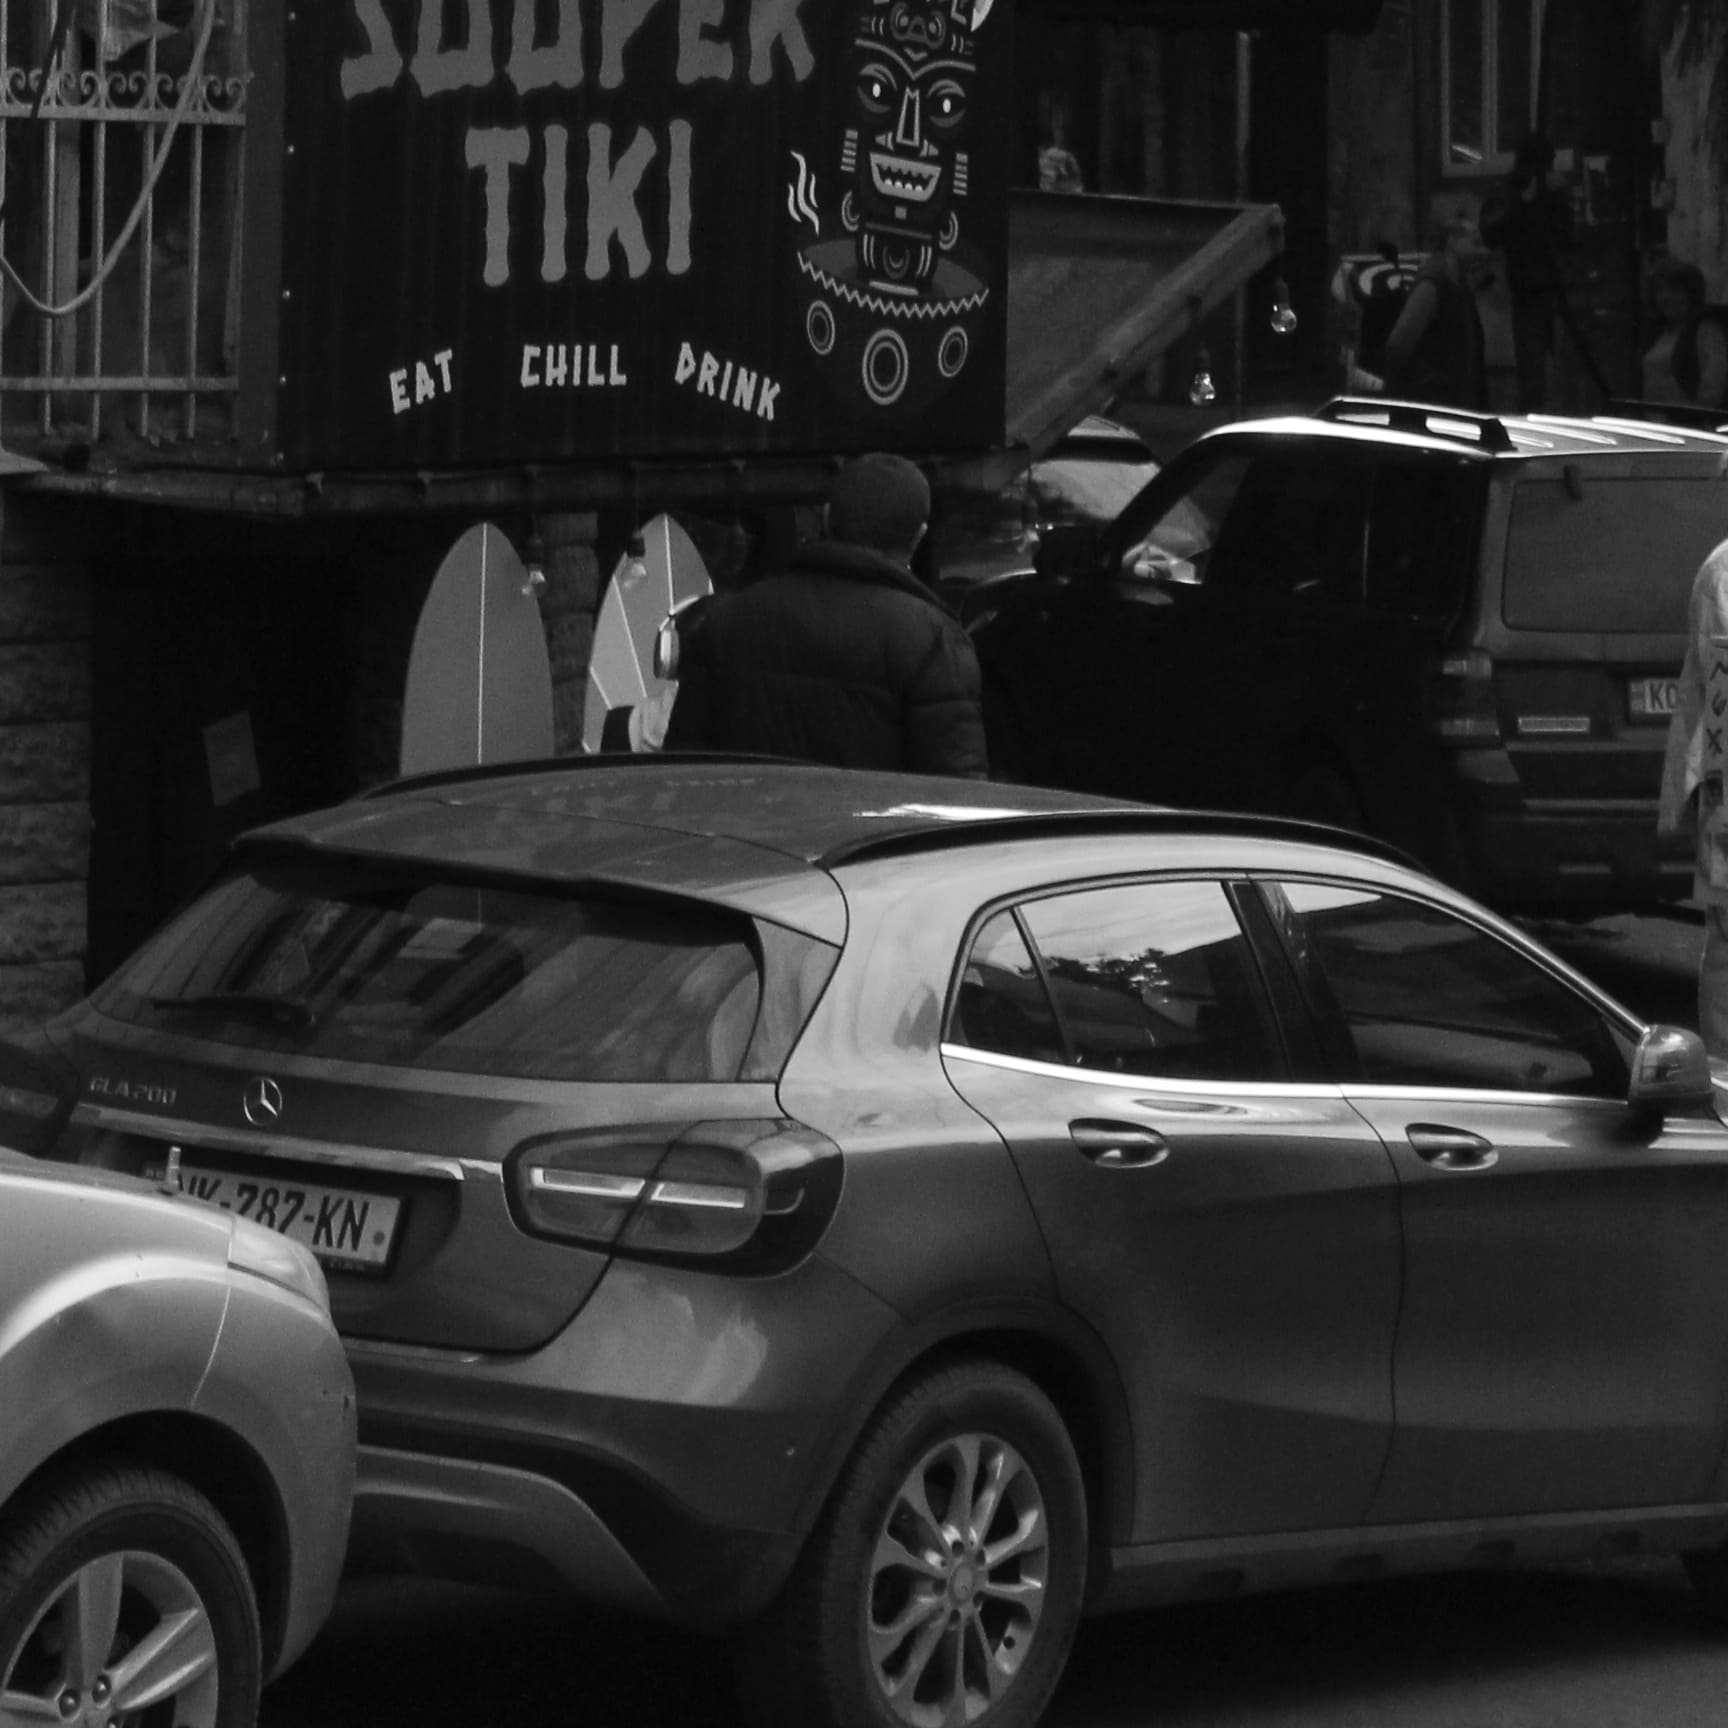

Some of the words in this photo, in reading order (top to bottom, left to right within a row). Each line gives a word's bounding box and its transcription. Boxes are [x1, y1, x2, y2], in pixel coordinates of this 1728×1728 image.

[465, 119, 694, 287] TIKI
[389, 348, 453, 415] EAT
[520, 343, 627, 388] CHILL
[675, 342, 781, 421] DRINK
